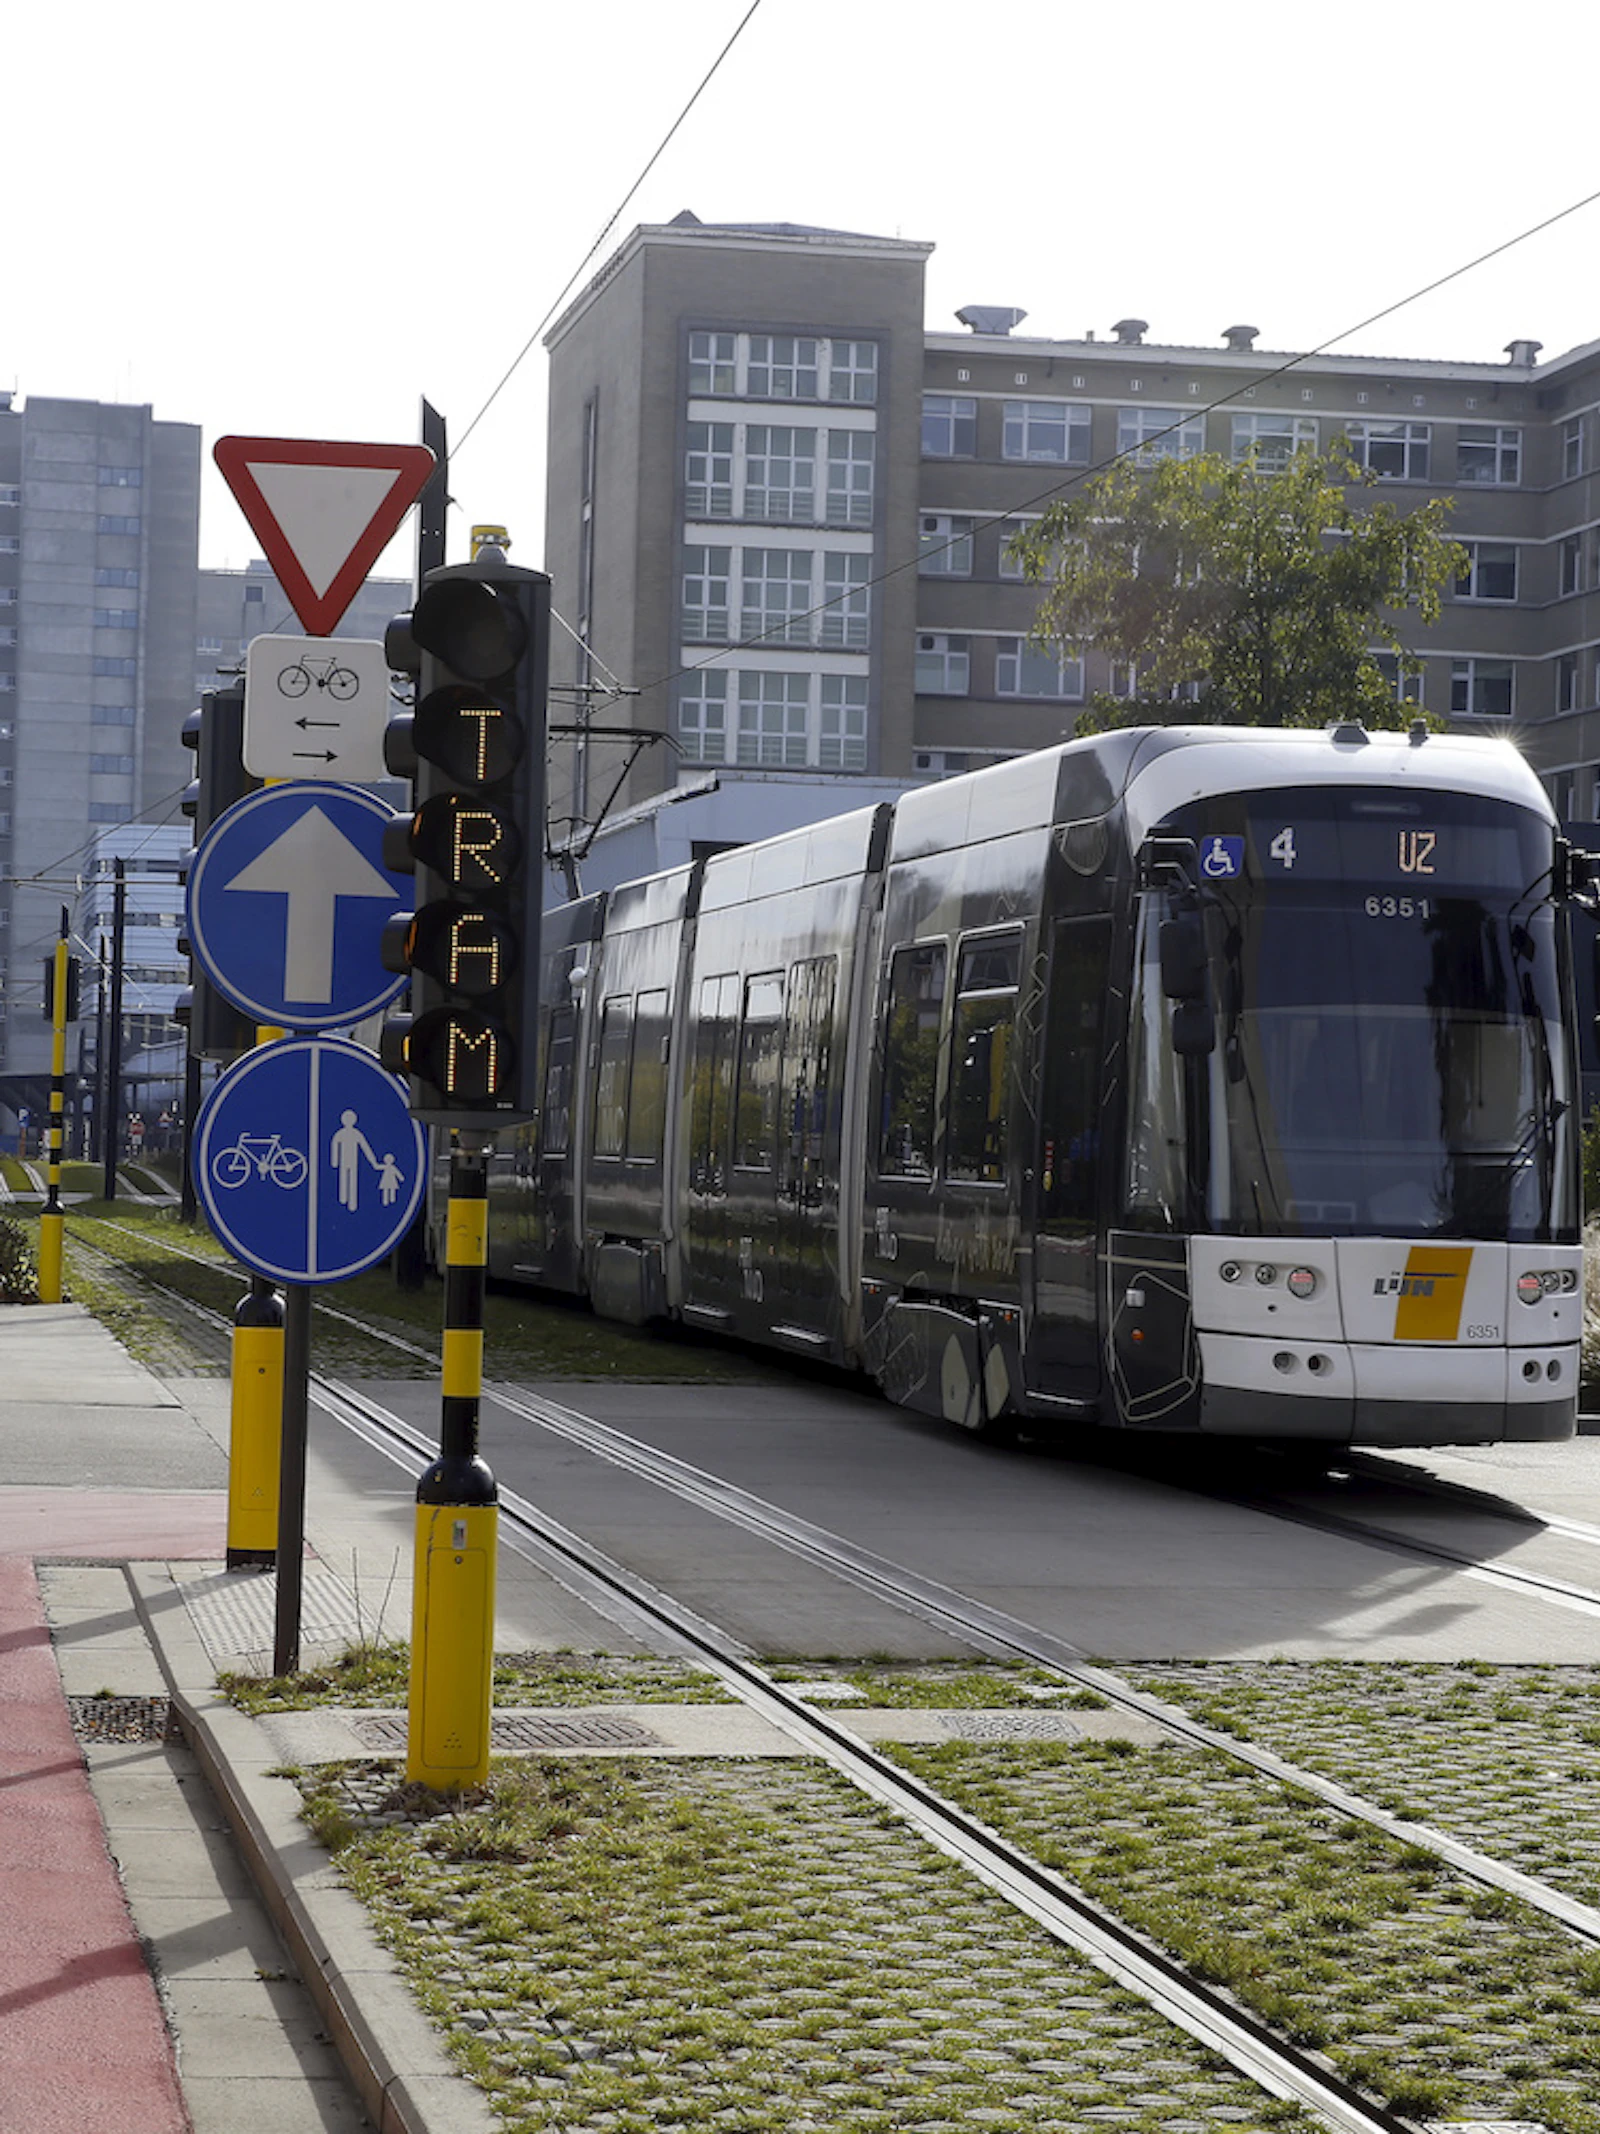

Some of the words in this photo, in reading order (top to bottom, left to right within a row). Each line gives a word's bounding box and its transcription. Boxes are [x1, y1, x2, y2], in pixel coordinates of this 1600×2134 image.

[1270, 827, 1297, 869] 4
[1399, 831, 1436, 873] UZ
[447, 708, 503, 1095] TRAM
[1365, 896, 1430, 919] 6351
[1467, 1324, 1499, 1339] 6351
